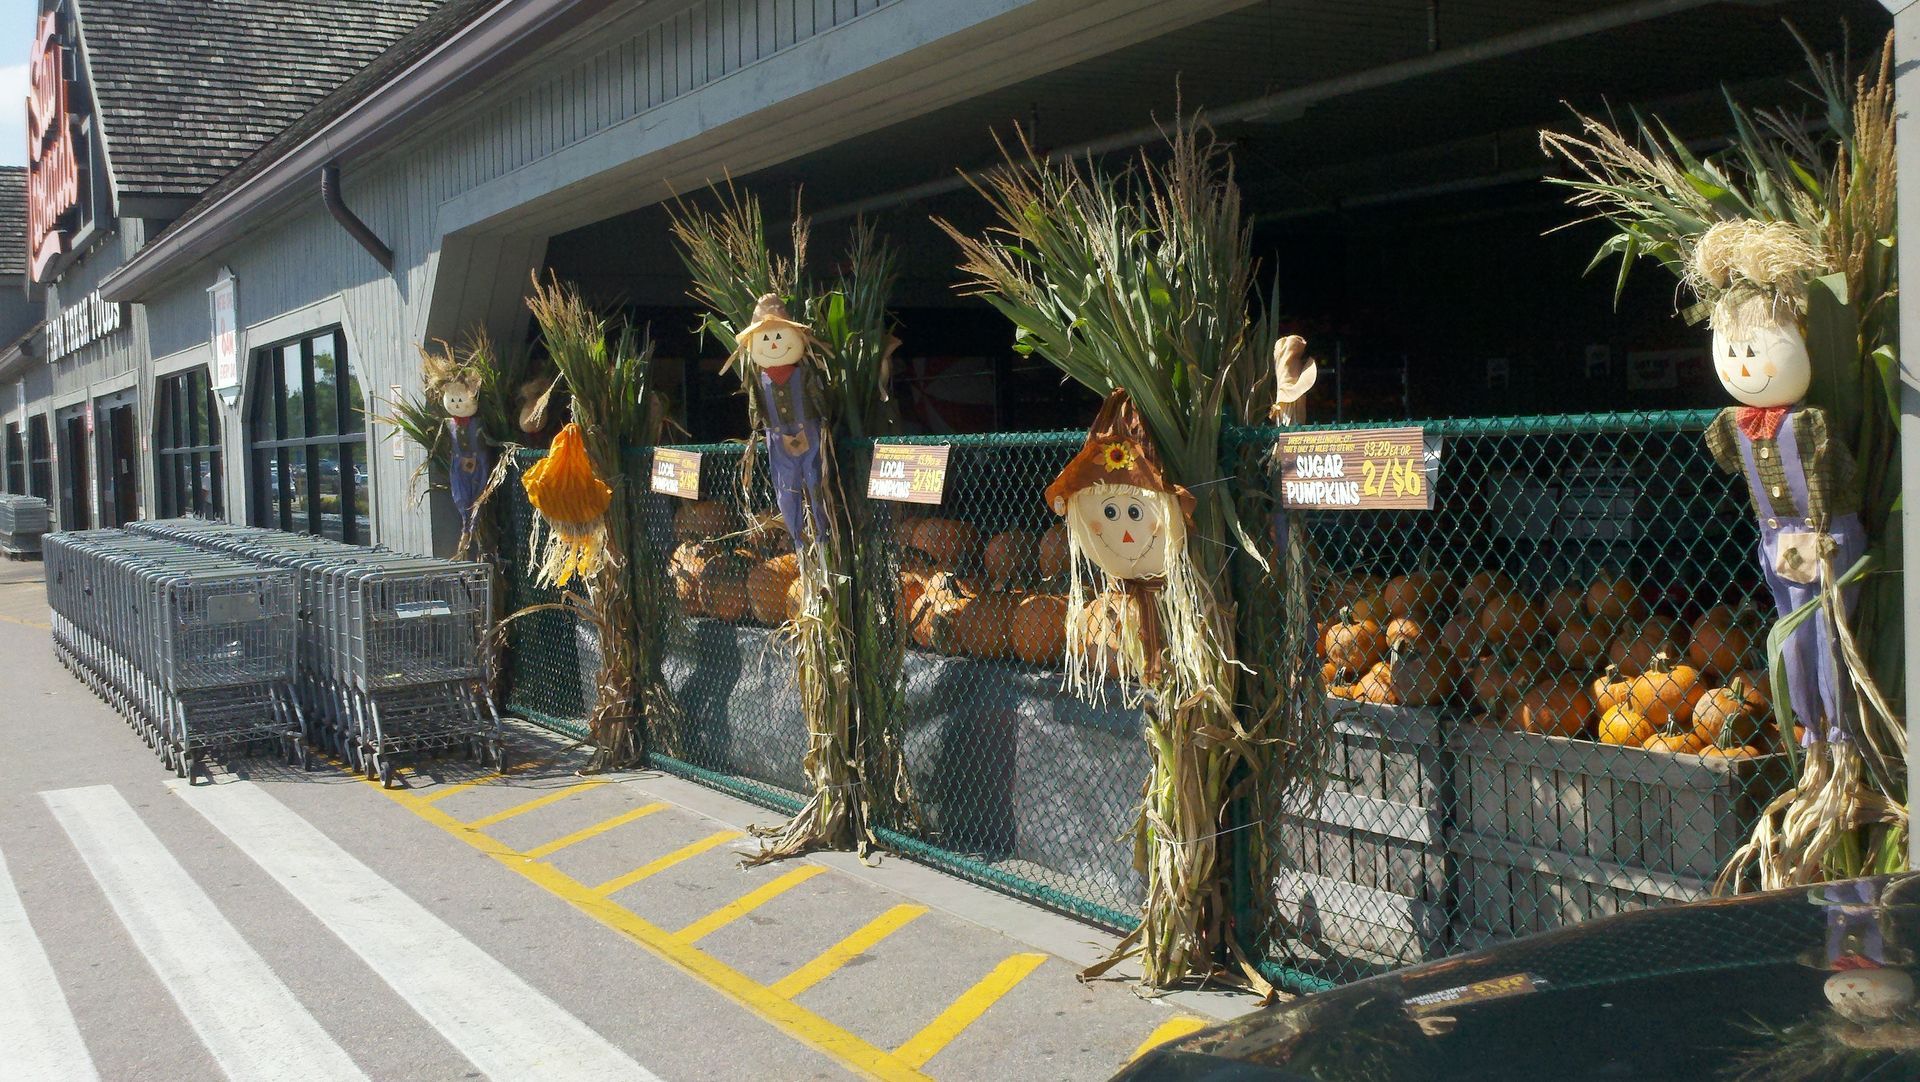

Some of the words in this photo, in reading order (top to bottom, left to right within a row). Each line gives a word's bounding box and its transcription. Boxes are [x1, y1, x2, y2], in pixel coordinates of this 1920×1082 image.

[1400, 445, 1412, 456] OR
[658, 461, 675, 478] LOCAL
[880, 460, 906, 479] LOCAL
[1296, 454, 1345, 479] SUGAR
[1362, 457, 1421, 498] 2/$6
[870, 478, 911, 498] PUMPKINS
[912, 467, 943, 493] 3/$15
[1285, 480, 1361, 506] PUMPKINS
